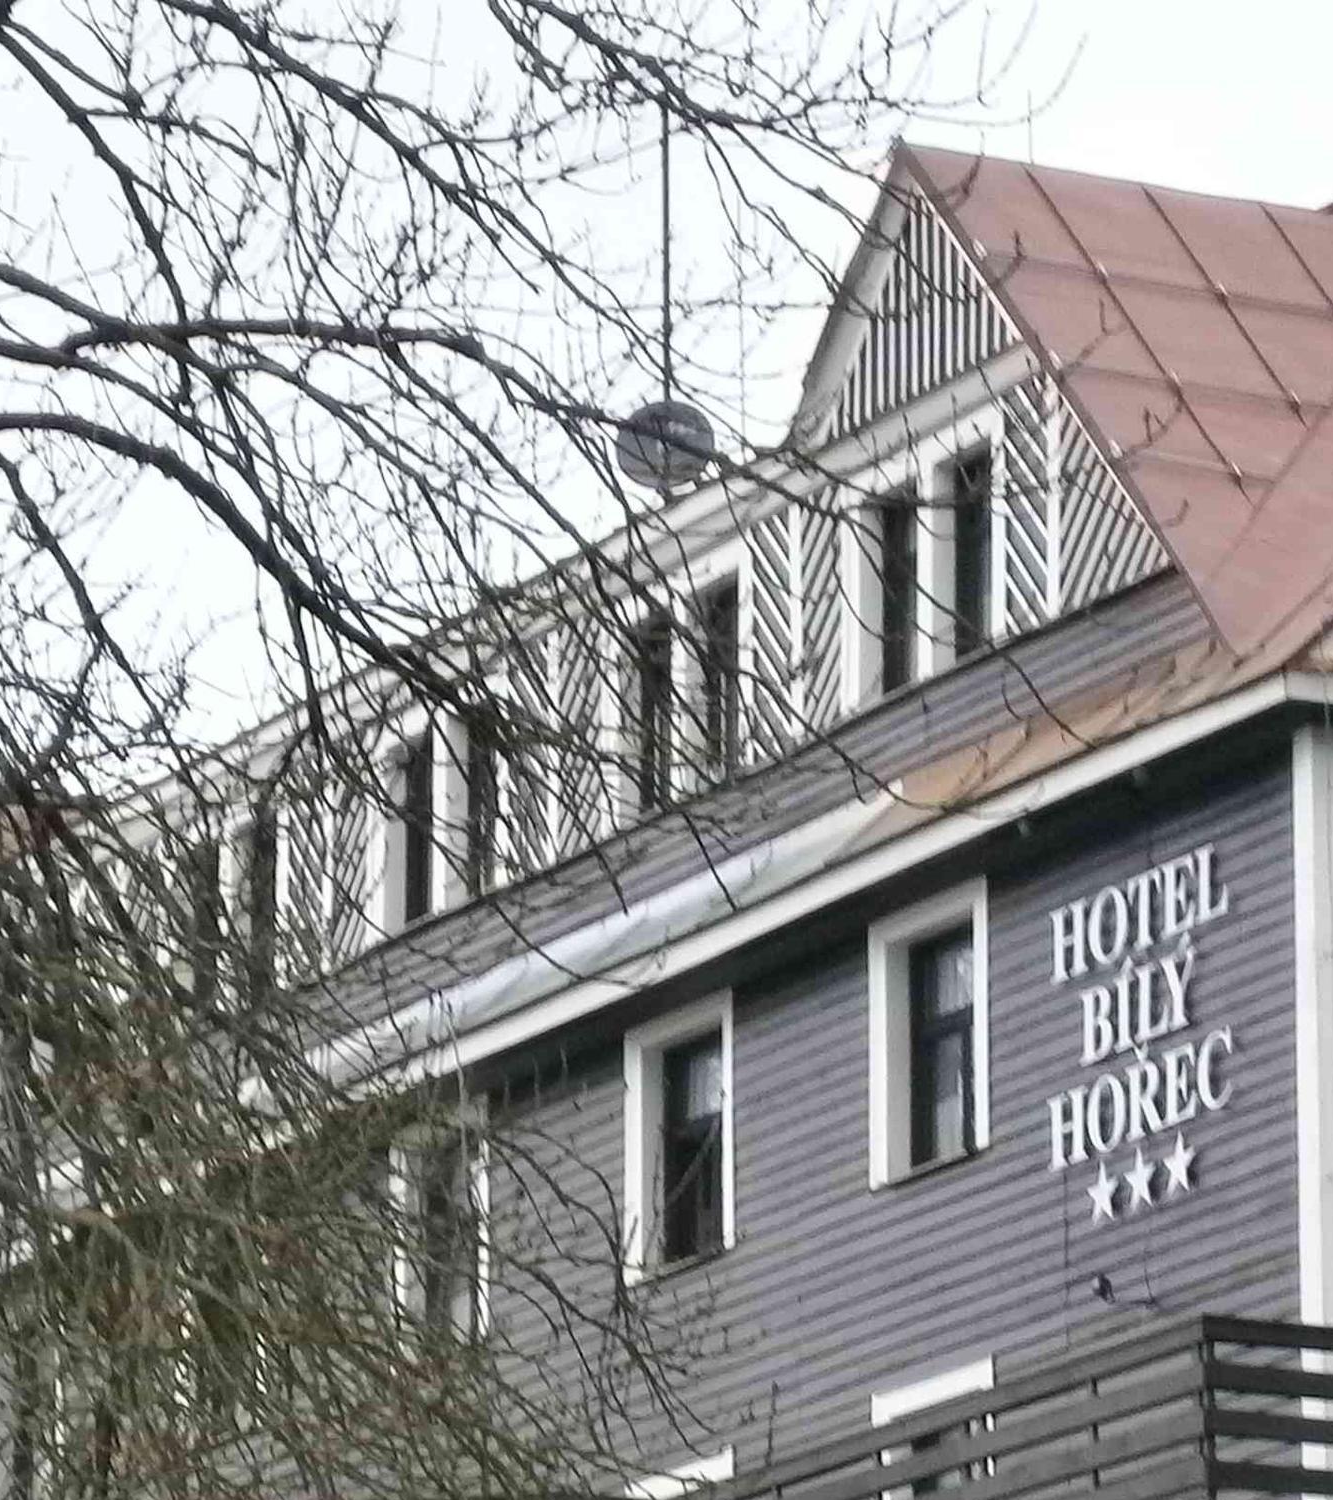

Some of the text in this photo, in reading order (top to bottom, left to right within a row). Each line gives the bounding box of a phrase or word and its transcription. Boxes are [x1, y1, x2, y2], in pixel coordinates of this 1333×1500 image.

[1048, 843, 1230, 985] HOTEL
[1079, 931, 1197, 1067] BÍLÝ
[1046, 1025, 1235, 1173] HOŘEC
